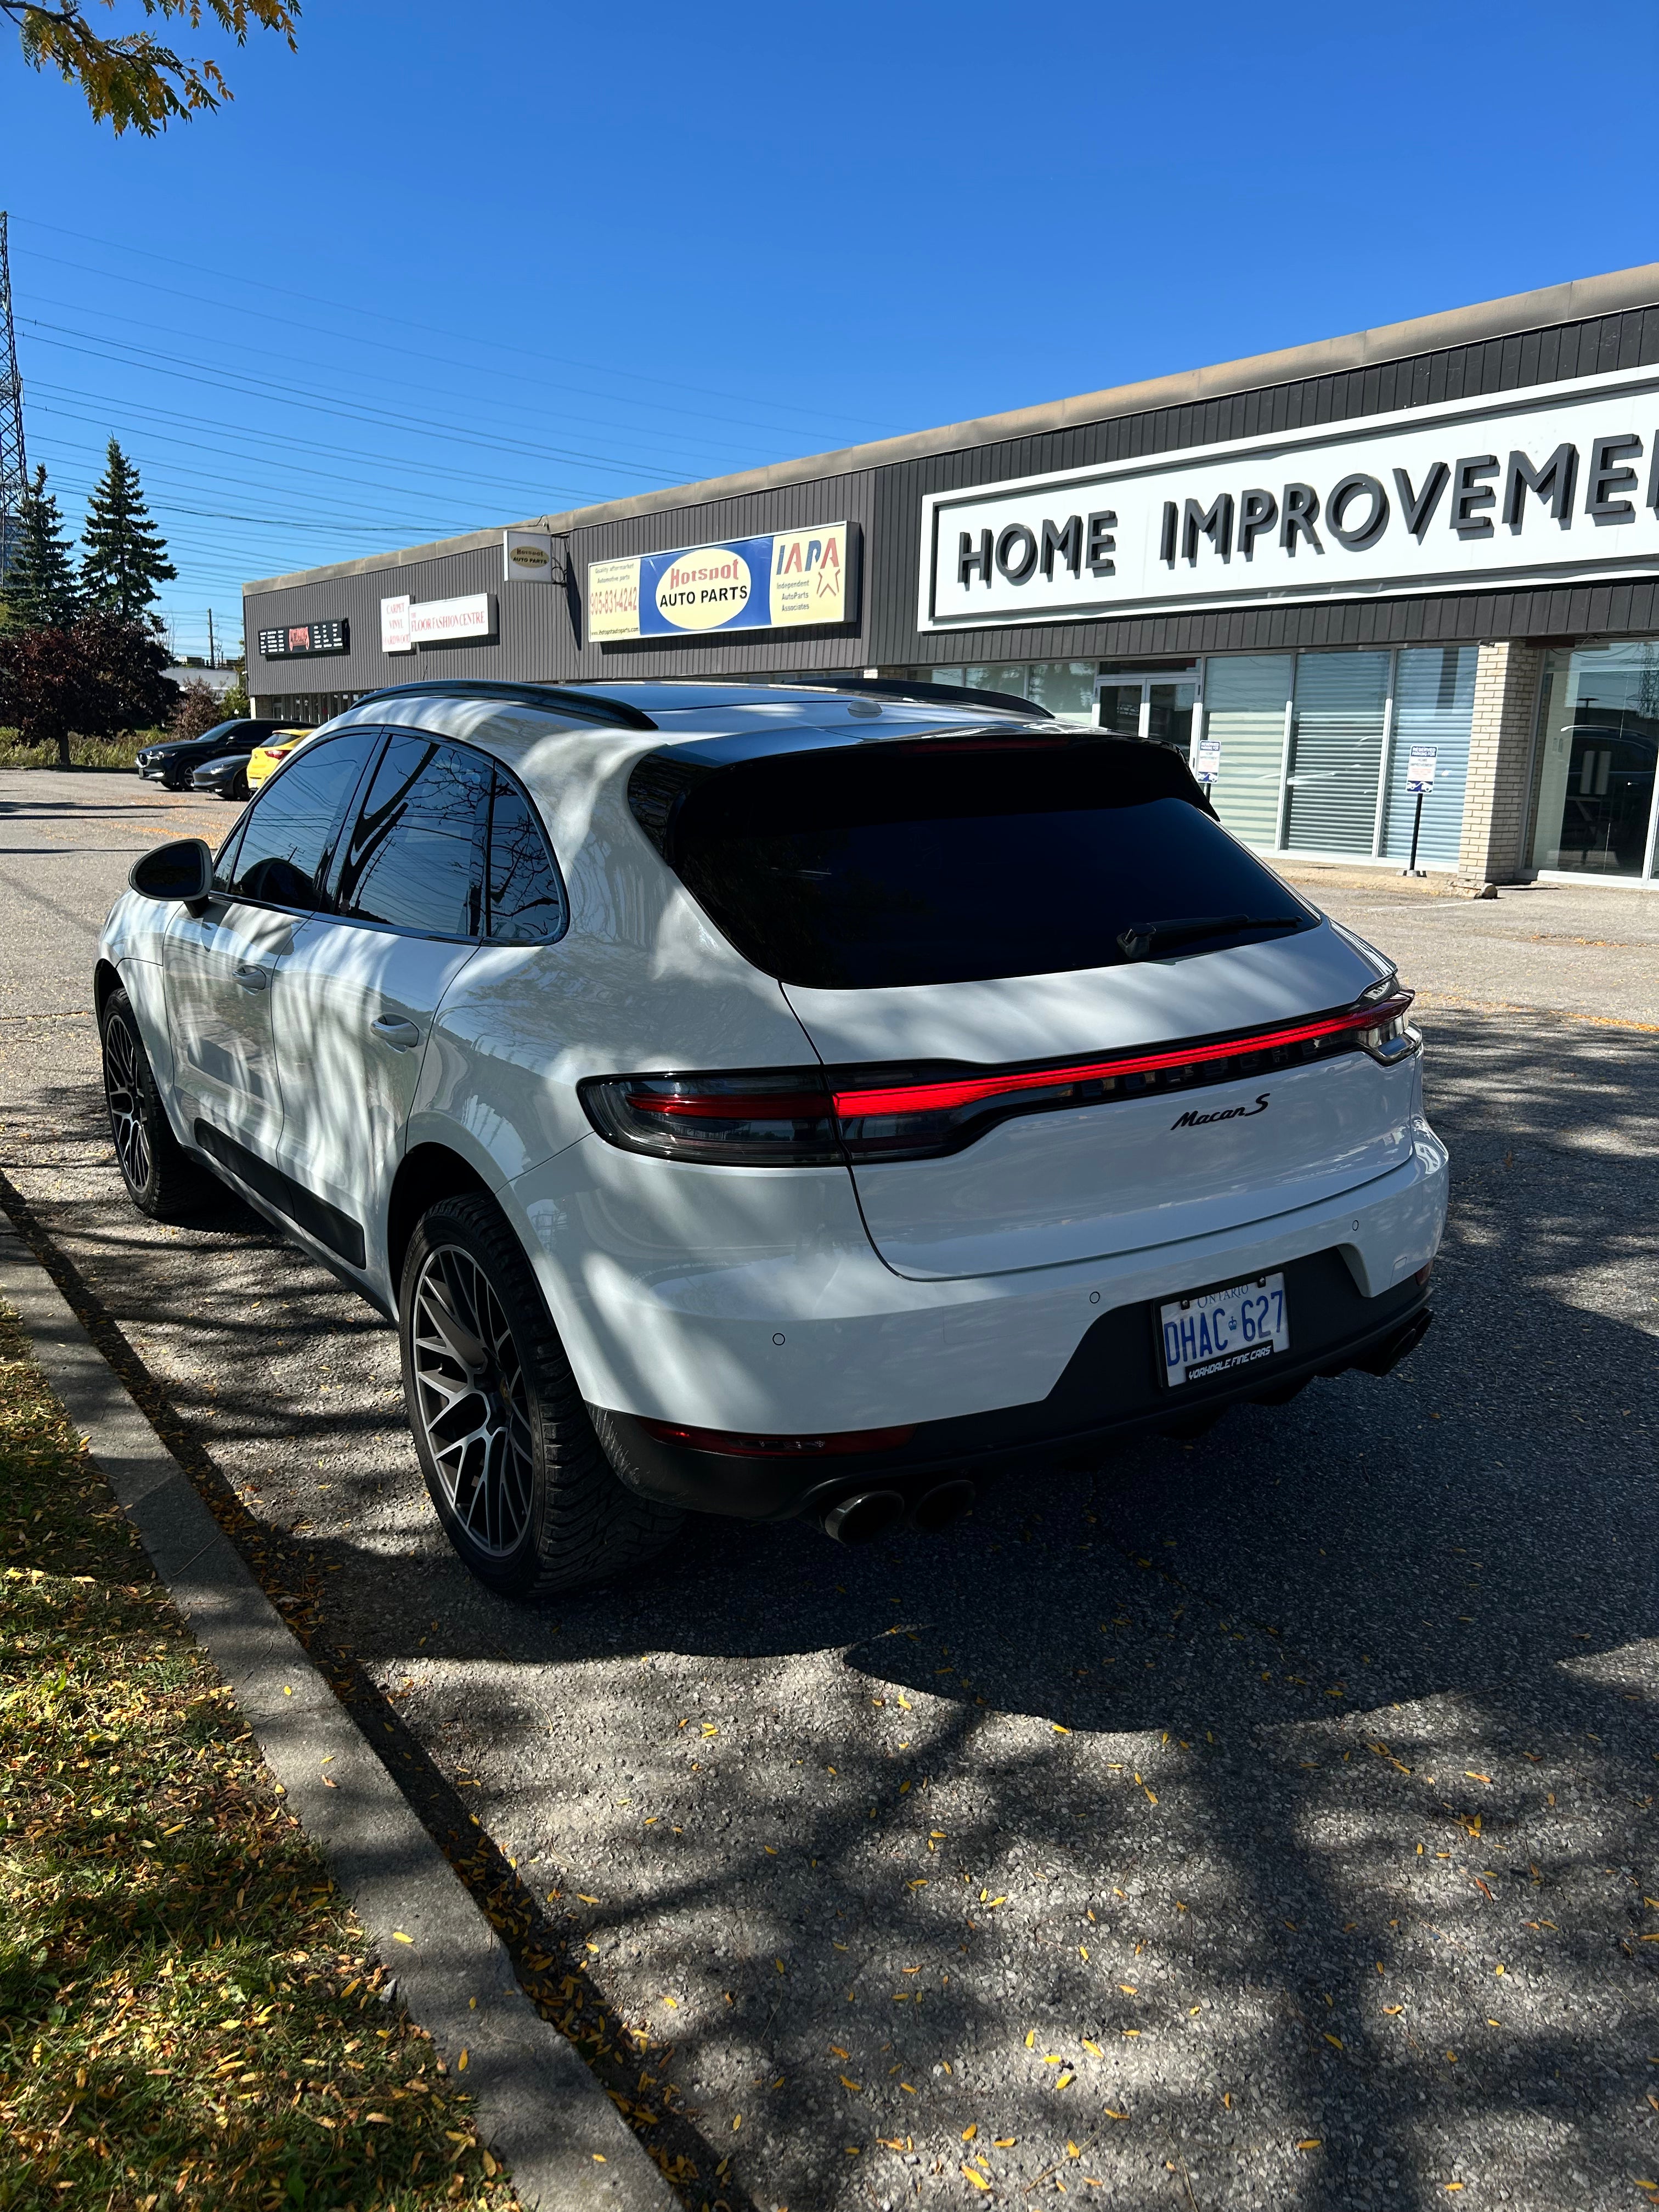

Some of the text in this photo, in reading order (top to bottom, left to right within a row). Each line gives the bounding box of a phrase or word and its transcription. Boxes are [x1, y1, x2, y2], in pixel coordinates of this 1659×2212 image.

[776, 537, 839, 575] IAPA
[957, 510, 1116, 584] HOME
[619, 574, 630, 583] parts
[670, 558, 739, 590] Hotspot
[776, 579, 810, 590] Independent
[660, 585, 748, 608] AUTO PARTS
[782, 592, 809, 601] AutoParts
[782, 603, 809, 612] Associates
[386, 602, 405, 614] CARPET
[389, 619, 404, 629] VINYL
[411, 611, 486, 632] FLOOR FASHION CENTRE
[1170, 1093, 1271, 1130] Macan S
[1164, 1290, 1283, 1367] DHAC 627
[1188, 1345, 1272, 1380] YORKDALE FINE CARS
